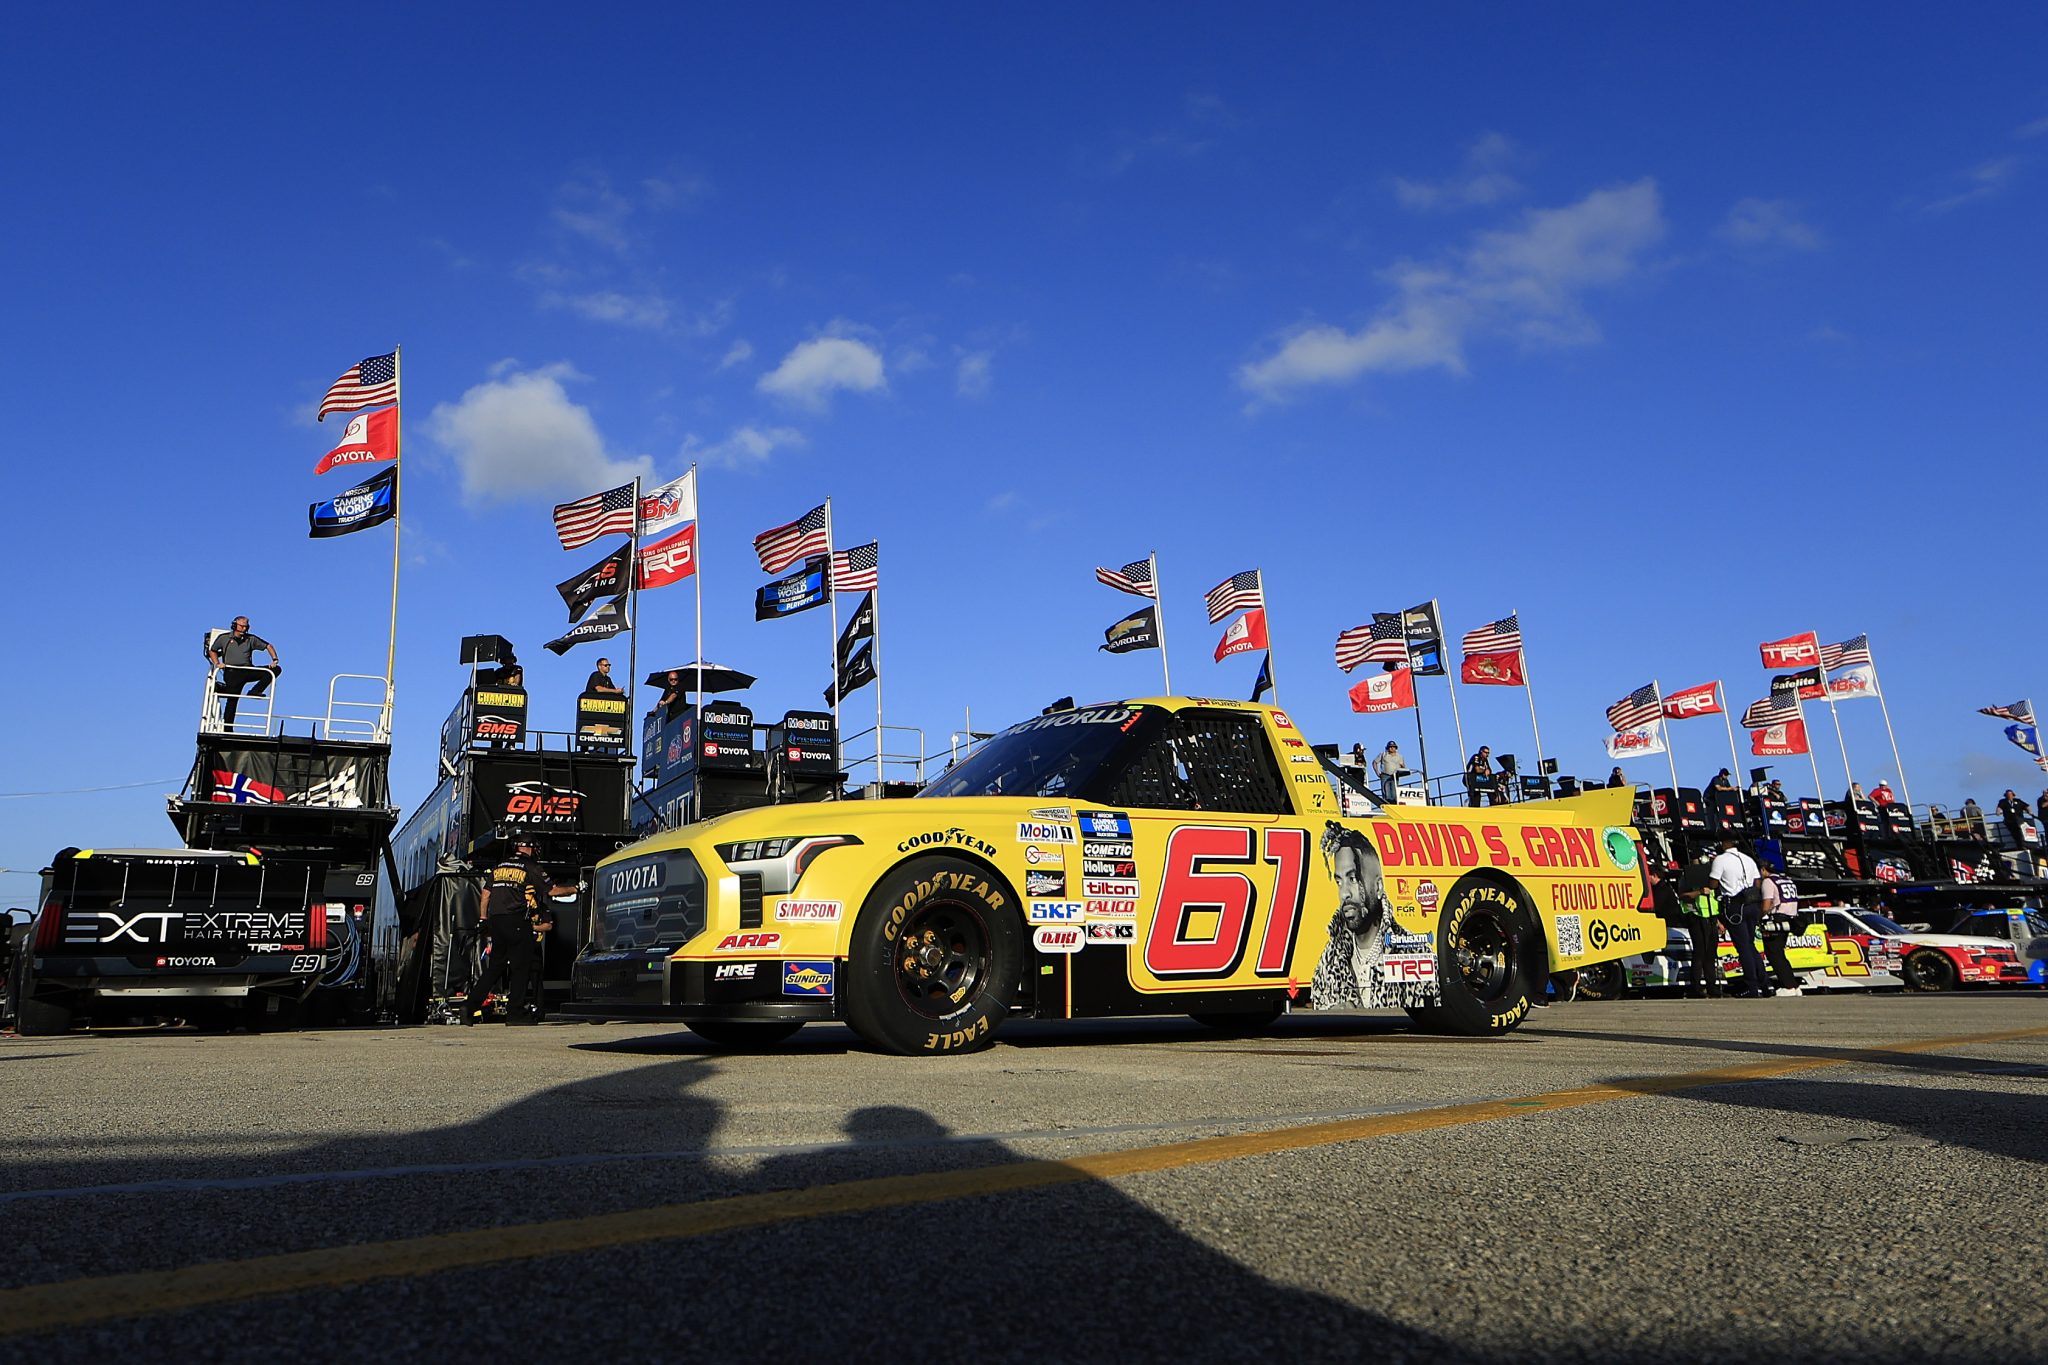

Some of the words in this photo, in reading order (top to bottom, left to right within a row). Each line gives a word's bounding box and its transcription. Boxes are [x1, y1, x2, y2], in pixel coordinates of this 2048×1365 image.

[331, 451, 375, 465] TOYOTA
[333, 493, 374, 507] CAMPING
[334, 501, 374, 516] WORLD
[778, 585, 807, 598] WORLD
[1222, 641, 1253, 655] TOYOTA
[1762, 645, 1815, 662] TRD
[1772, 678, 1816, 690] Safelite
[477, 692, 524, 706] CHAMPION
[580, 699, 626, 712] CHAMPION
[1661, 694, 1714, 715] TRD
[1366, 702, 1398, 712] TOYOTA
[705, 712, 736, 725] Mobil
[787, 717, 817, 730] Mobil
[1033, 709, 1131, 731] WORLD
[477, 723, 518, 734] GMS
[579, 736, 624, 744] CHEVROLET
[719, 747, 750, 756] TOYOTA
[801, 752, 831, 761] TOYOTA
[1290, 755, 1314, 763] HRE
[1295, 774, 1327, 783] AISIN
[1400, 790, 1425, 798] HRE
[506, 795, 580, 815] GMS
[1020, 823, 1058, 839] Mobil
[1060, 826, 1073, 840] 1
[1084, 843, 1132, 856] COMETIC
[1372, 822, 1479, 867] DAVID
[1482, 825, 1521, 867] S.
[1520, 826, 1600, 868] GRAY
[1084, 861, 1115, 876] Holley
[356, 873, 373, 886] 99
[610, 864, 659, 895] TOYOTA
[1087, 882, 1136, 895] tilton
[1417, 884, 1438, 894] BAMA
[1144, 824, 1312, 982] 61
[1552, 883, 1597, 911] FOUND
[1600, 883, 1635, 910] LOVE
[779, 903, 836, 918] SIMPSON
[1032, 903, 1081, 918] SKF
[1086, 900, 1135, 913] CALICO
[65, 912, 184, 943] EXT
[185, 913, 305, 928] EXTREME
[184, 930, 223, 939] HAIR
[228, 930, 305, 939] THERAPY
[1088, 924, 1133, 938] KOOKS
[1609, 924, 1641, 942] Coin
[717, 934, 780, 949] ARP
[168, 957, 216, 966] TOYOTA
[290, 954, 320, 973] 99
[715, 963, 757, 978] HRE
[1385, 960, 1434, 981] TRD
[787, 975, 829, 984] SUNOCO
[1491, 995, 1528, 1027] EAGLE
[924, 1015, 989, 1050] EAGLE
